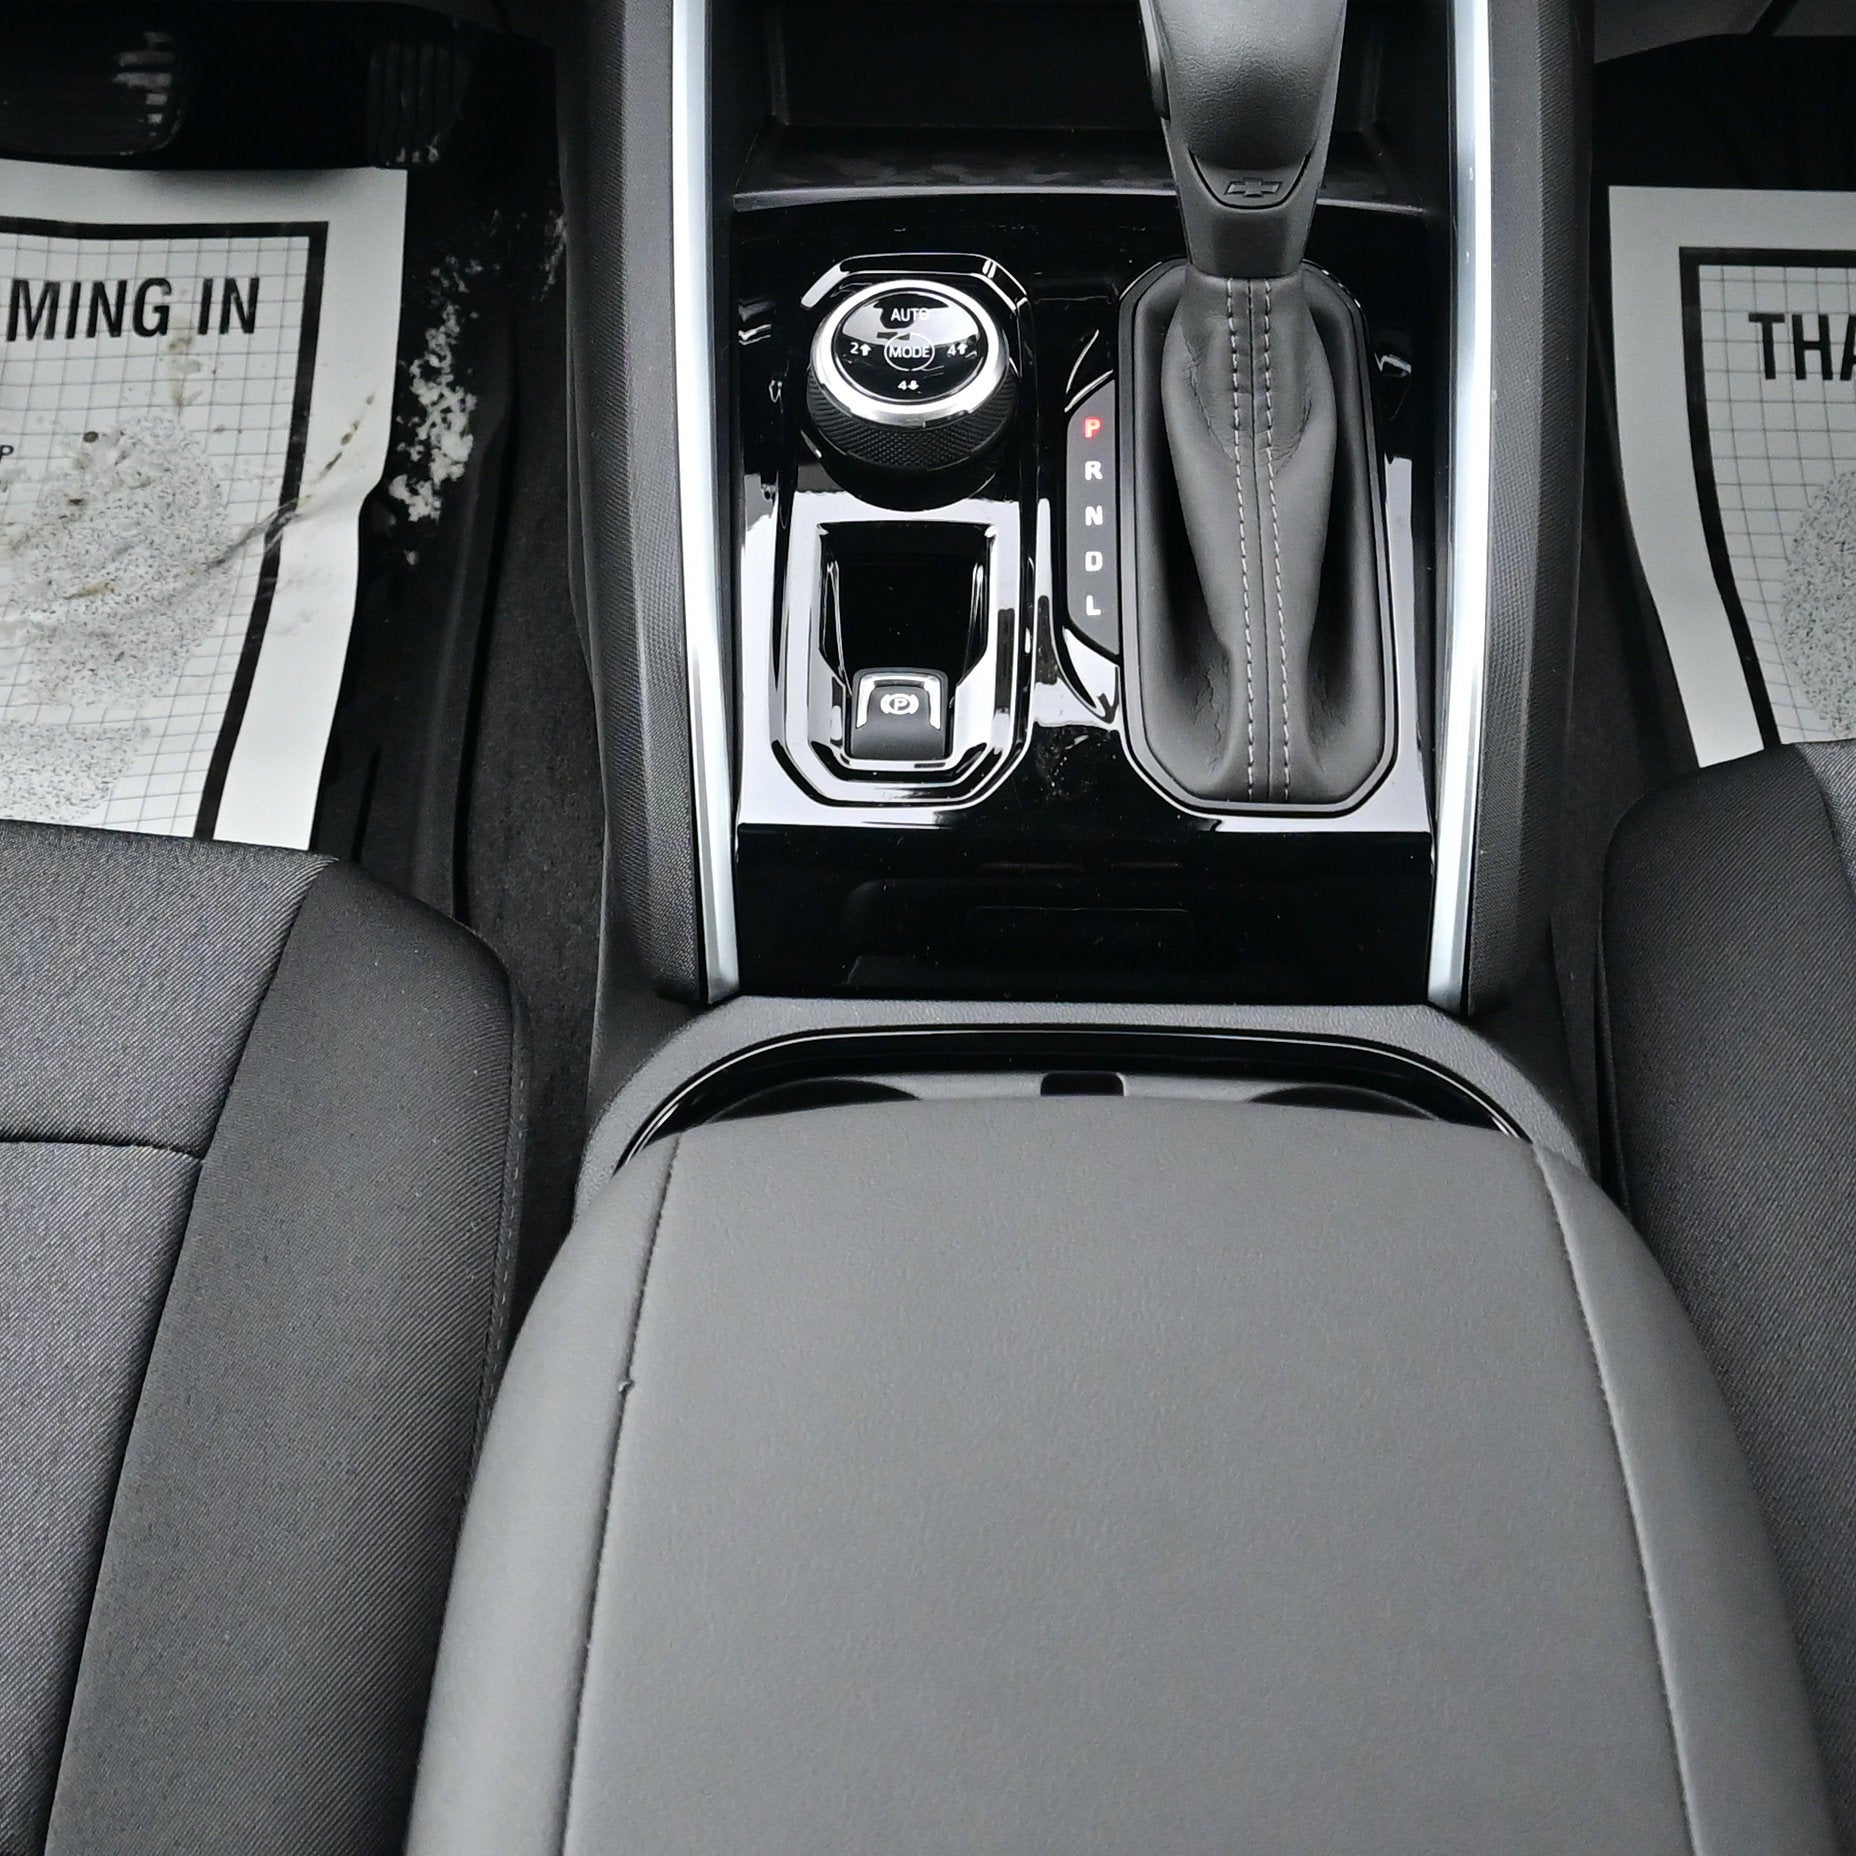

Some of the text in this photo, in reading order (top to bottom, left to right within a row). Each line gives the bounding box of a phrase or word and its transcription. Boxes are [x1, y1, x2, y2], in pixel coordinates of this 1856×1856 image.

[195, 275, 262, 336] IN
[890, 307, 928, 321] AUTO
[888, 345, 931, 358] MODE
[1084, 418, 1100, 437] P
[1084, 460, 1101, 480] R
[1084, 505, 1102, 525] N
[1085, 550, 1102, 570] D
[1086, 595, 1100, 615] L
